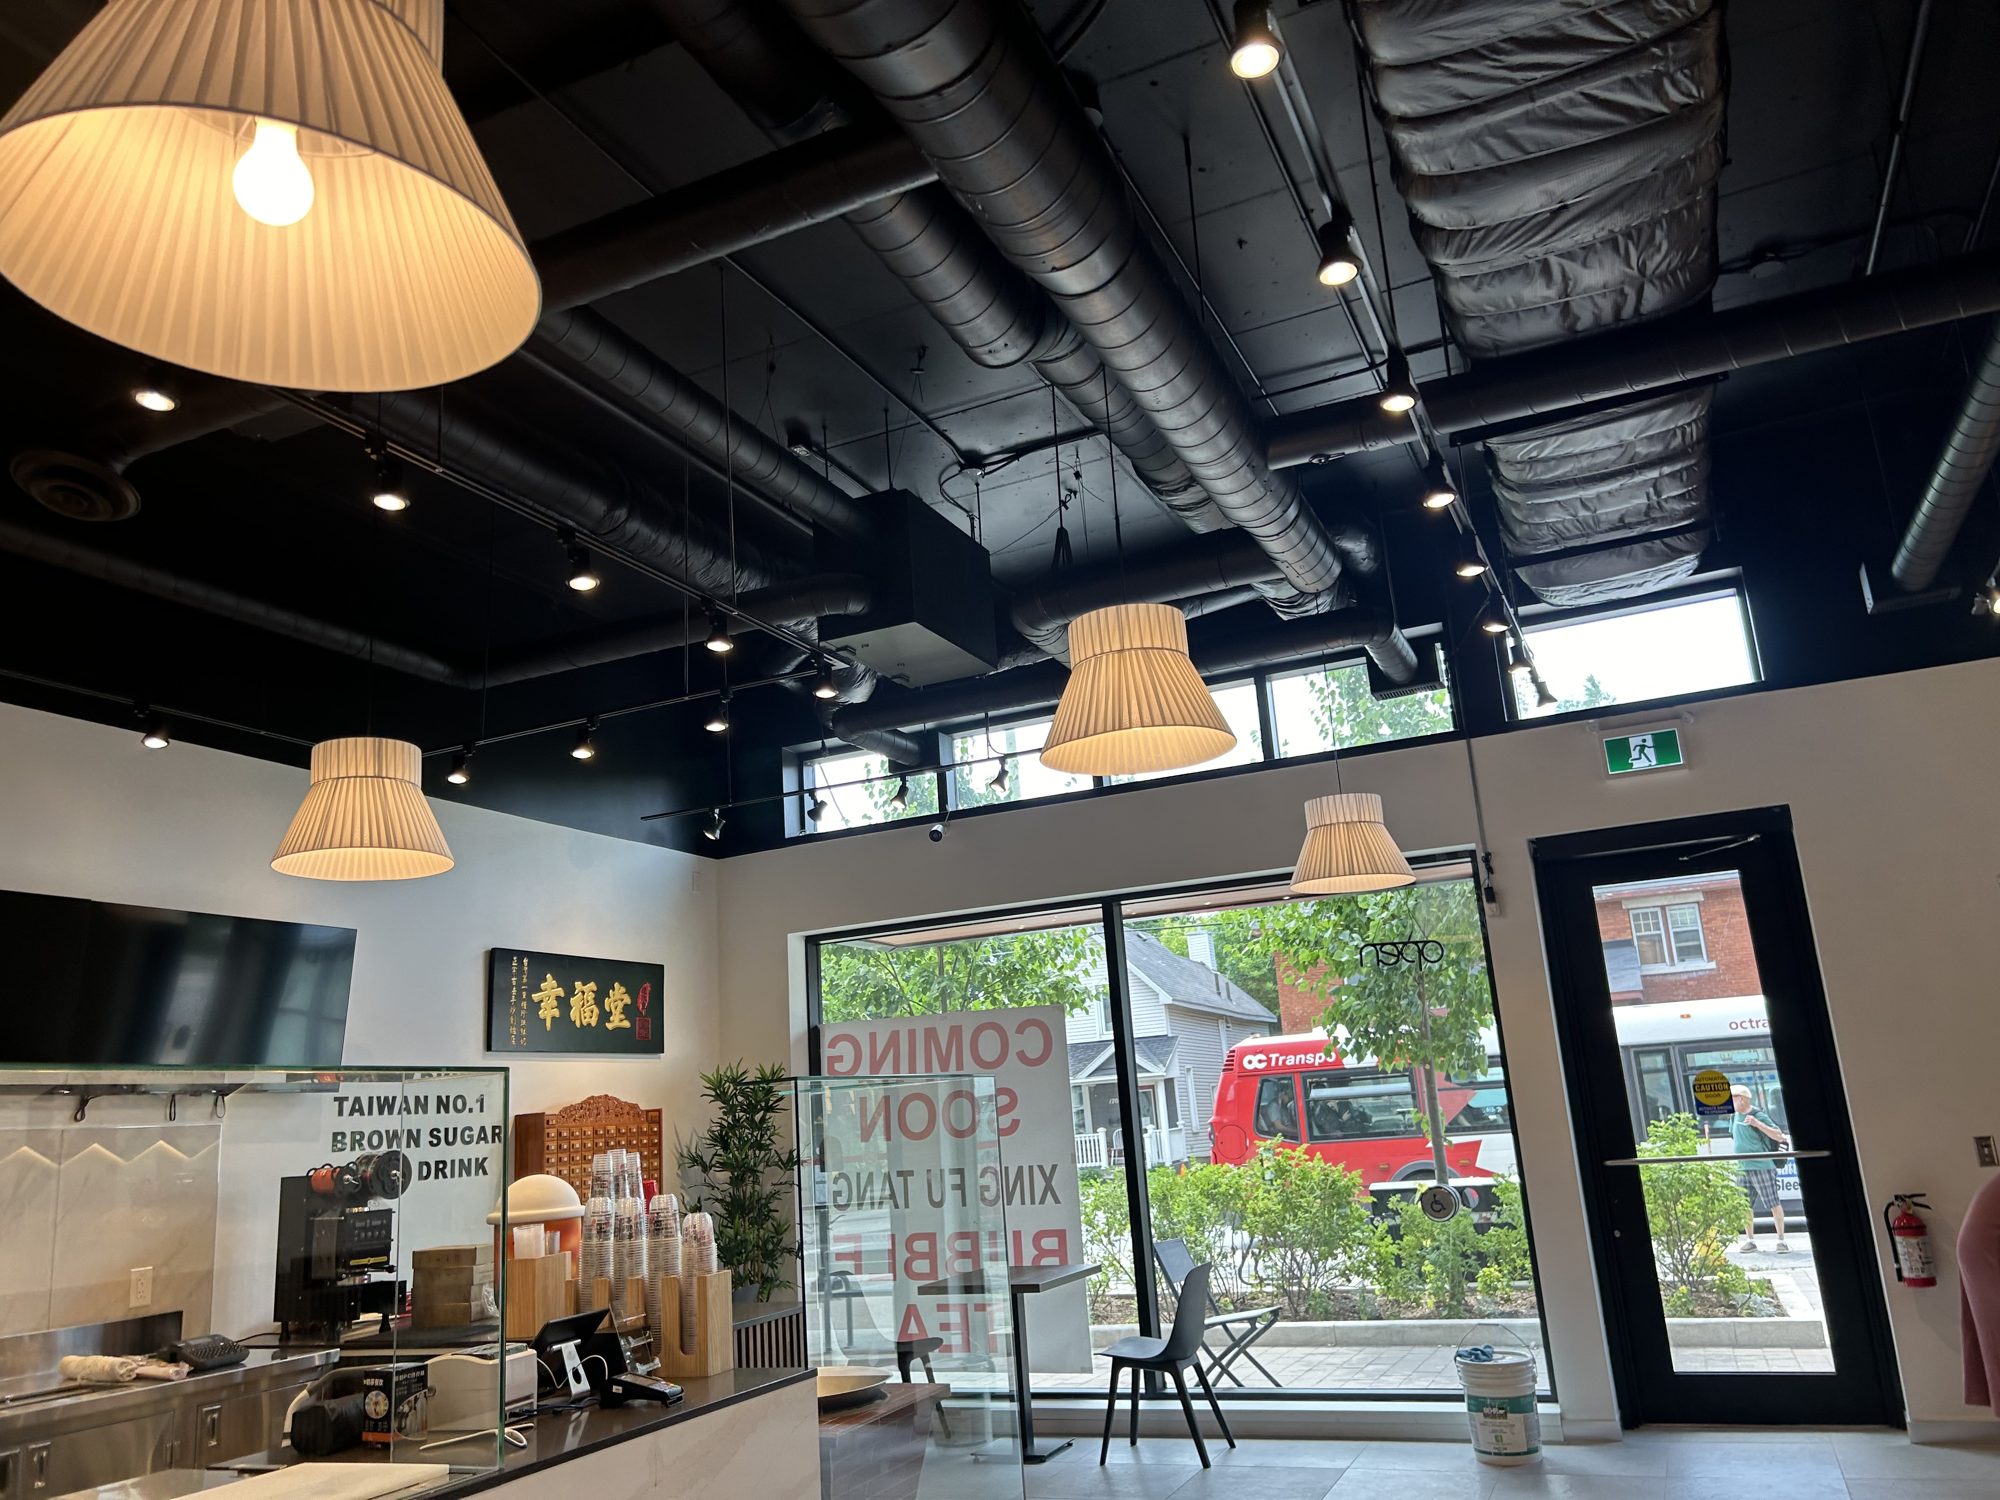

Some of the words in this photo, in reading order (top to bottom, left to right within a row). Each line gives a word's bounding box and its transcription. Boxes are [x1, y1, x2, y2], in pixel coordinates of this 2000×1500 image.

[531, 973, 632, 1032] 幸福堂
[1729, 1018, 1770, 1031] octra
[1695, 1083, 1729, 1092] CAUTION
[333, 1095, 428, 1117] TAIWAN
[436, 1094, 485, 1115] NO.1
[331, 1128, 421, 1153] BROWN
[428, 1125, 502, 1148] SUGAR
[418, 1157, 489, 1181] DRINK
